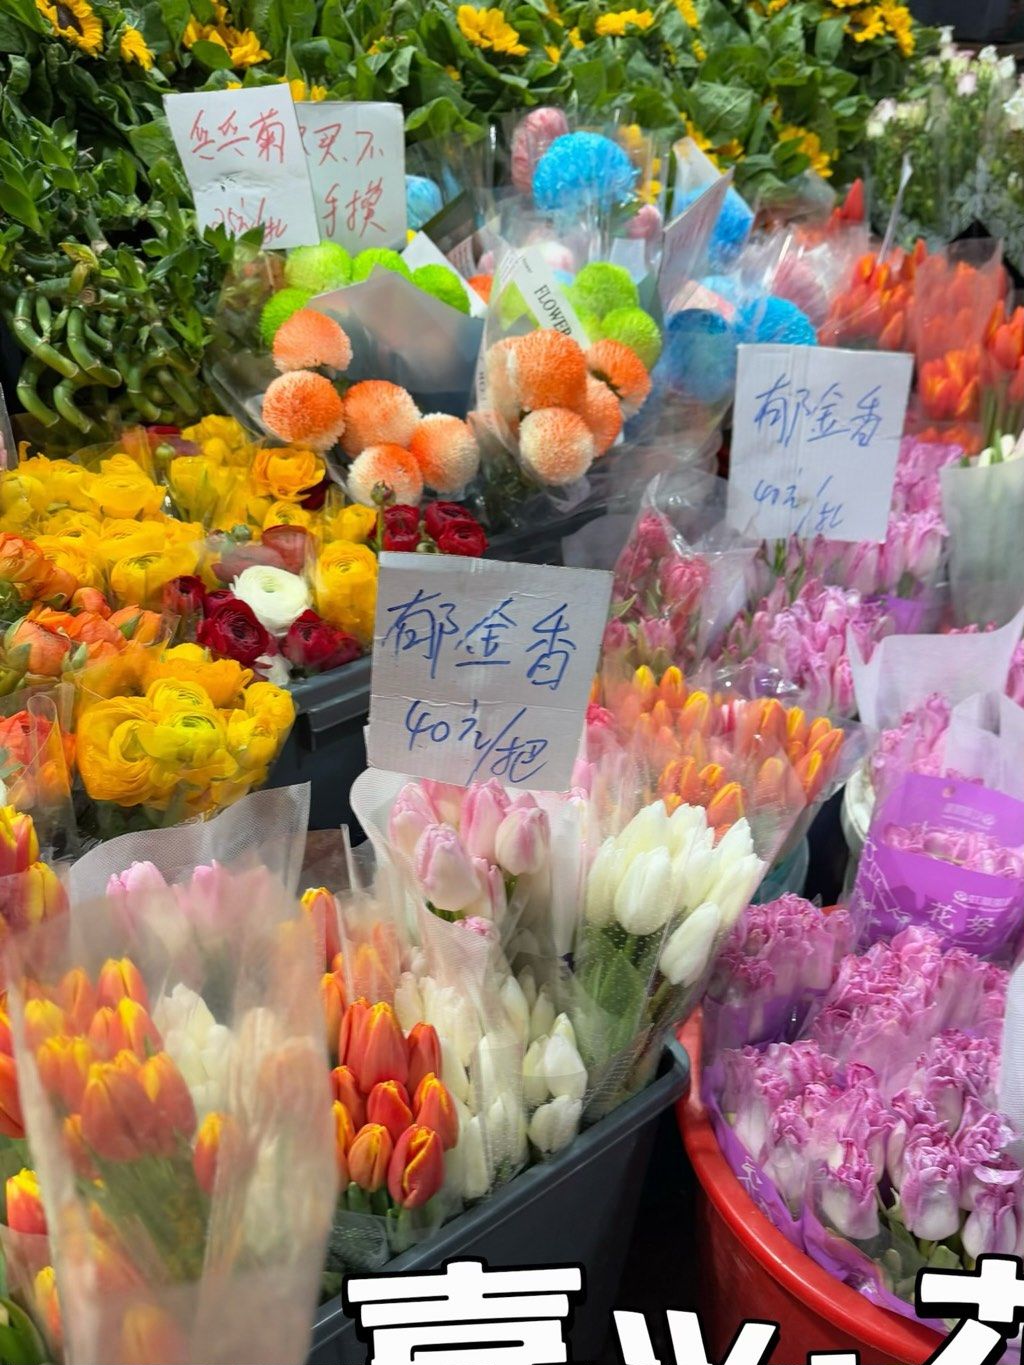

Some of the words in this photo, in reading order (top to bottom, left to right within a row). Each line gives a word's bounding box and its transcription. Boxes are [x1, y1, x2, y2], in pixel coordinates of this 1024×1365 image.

[754, 373, 883, 447] 郁金香
[382, 589, 577, 691] 郁金香
[405, 699, 549, 787] 40元/把
